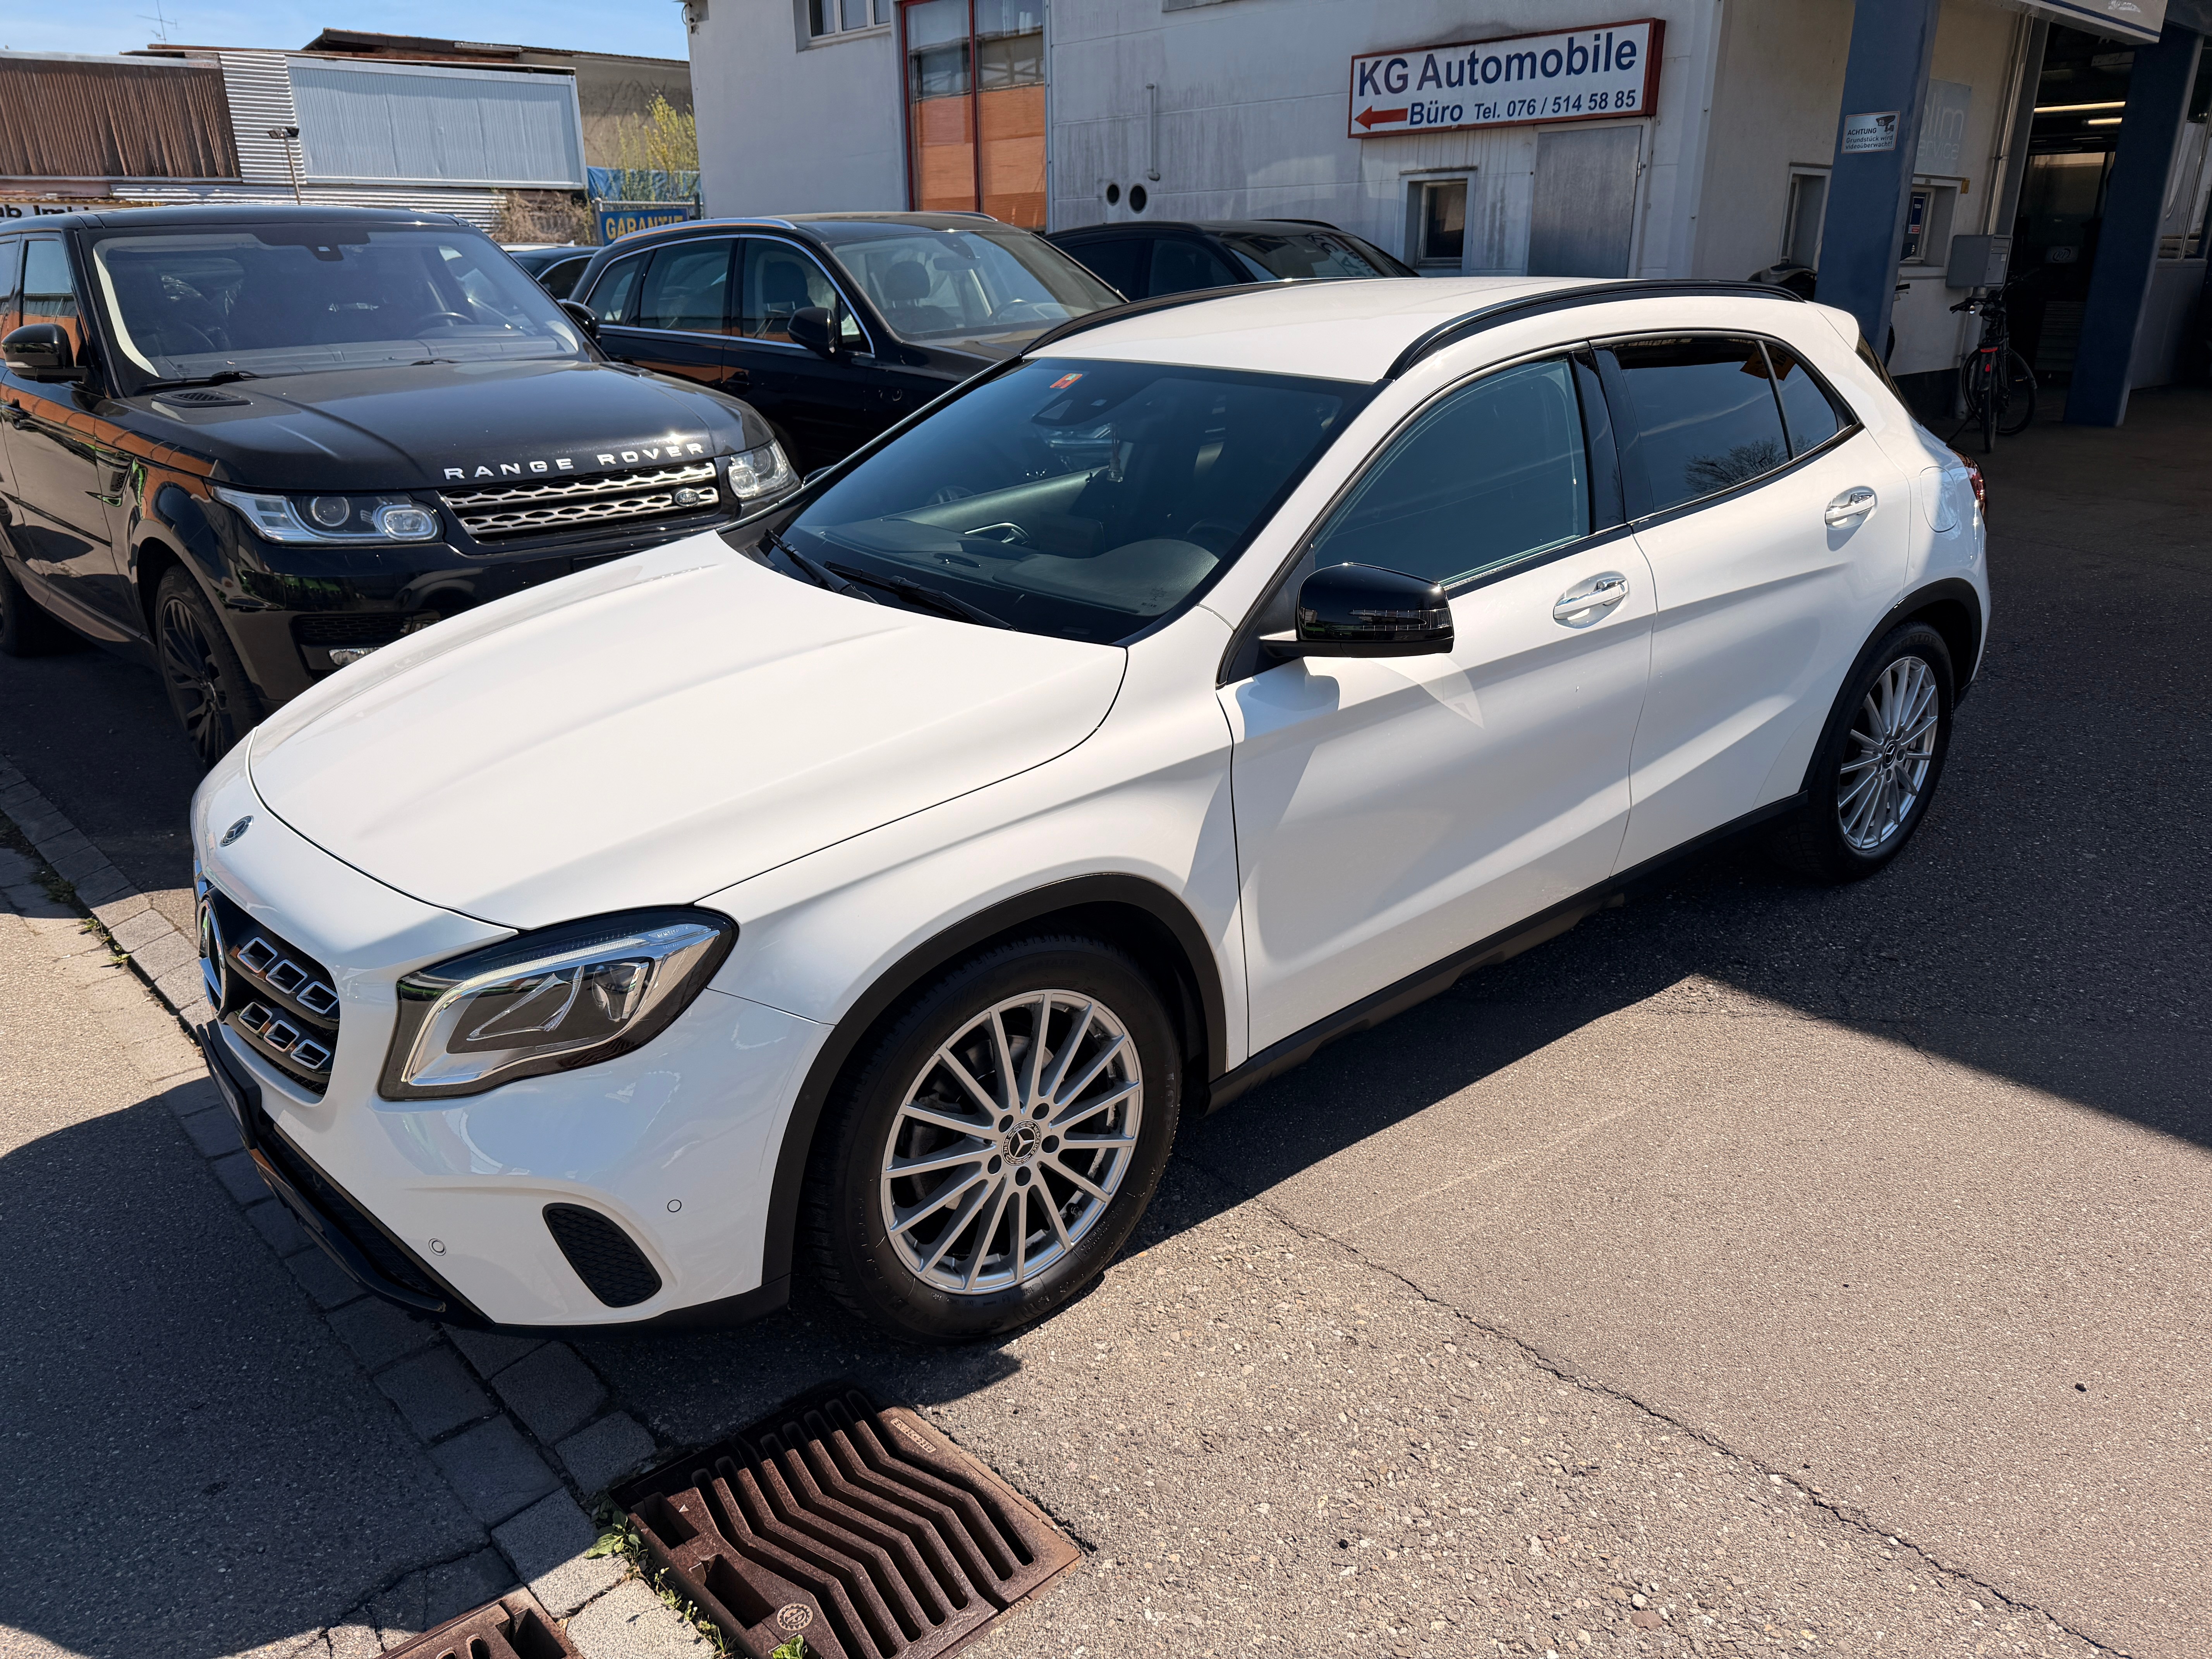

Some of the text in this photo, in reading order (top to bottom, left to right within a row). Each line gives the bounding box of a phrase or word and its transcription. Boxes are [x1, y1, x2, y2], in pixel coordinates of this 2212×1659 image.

[1358, 32, 1637, 97] KG Automobile
[1409, 89, 1636, 125] Büro Tel. 076 / 514 58 85
[1846, 141, 1893, 149] videoüberwacht!
[444, 443, 704, 480] RANGE ROVER
